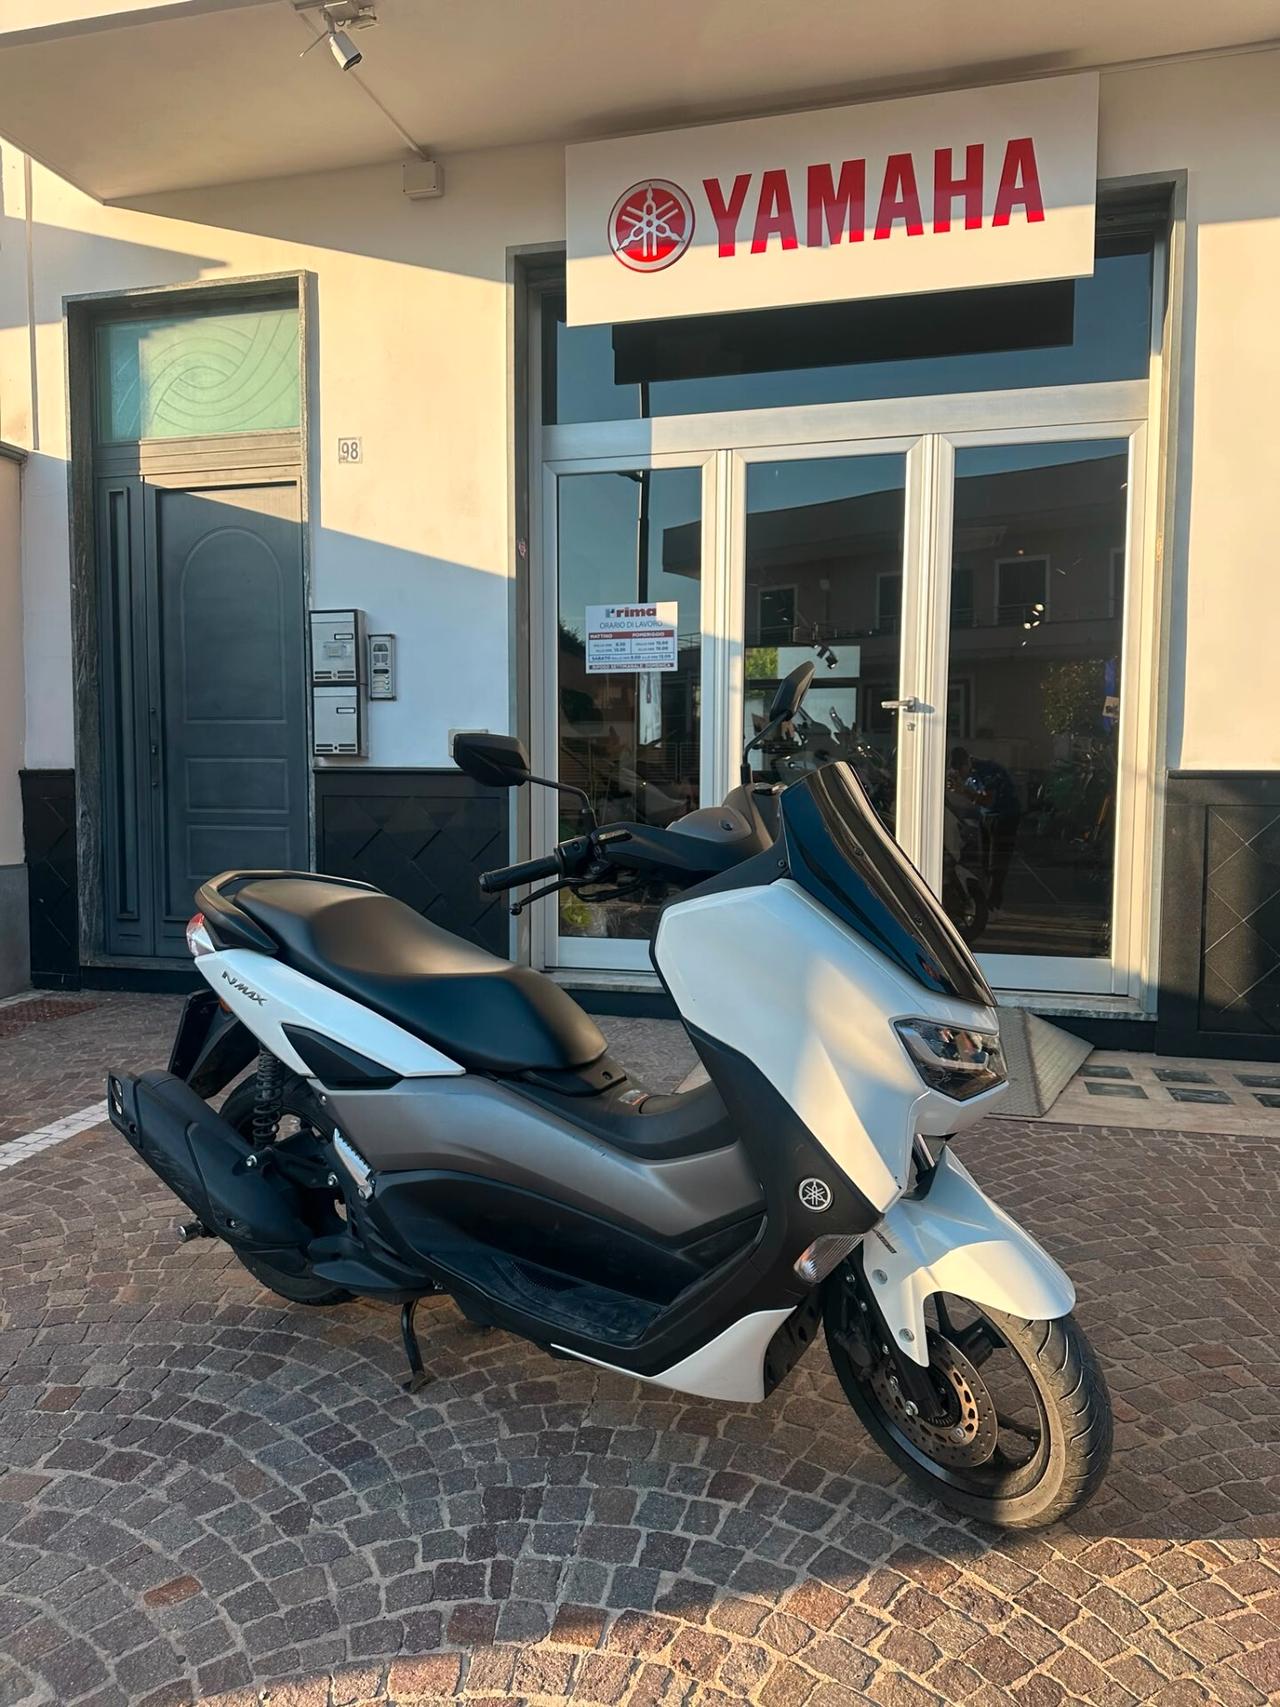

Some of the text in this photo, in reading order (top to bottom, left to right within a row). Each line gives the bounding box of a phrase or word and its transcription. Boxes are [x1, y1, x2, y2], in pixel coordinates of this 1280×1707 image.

[702, 137, 1045, 258] YAMAHA
[341, 441, 358, 460] 98
[222, 970, 267, 1006] NMAX
